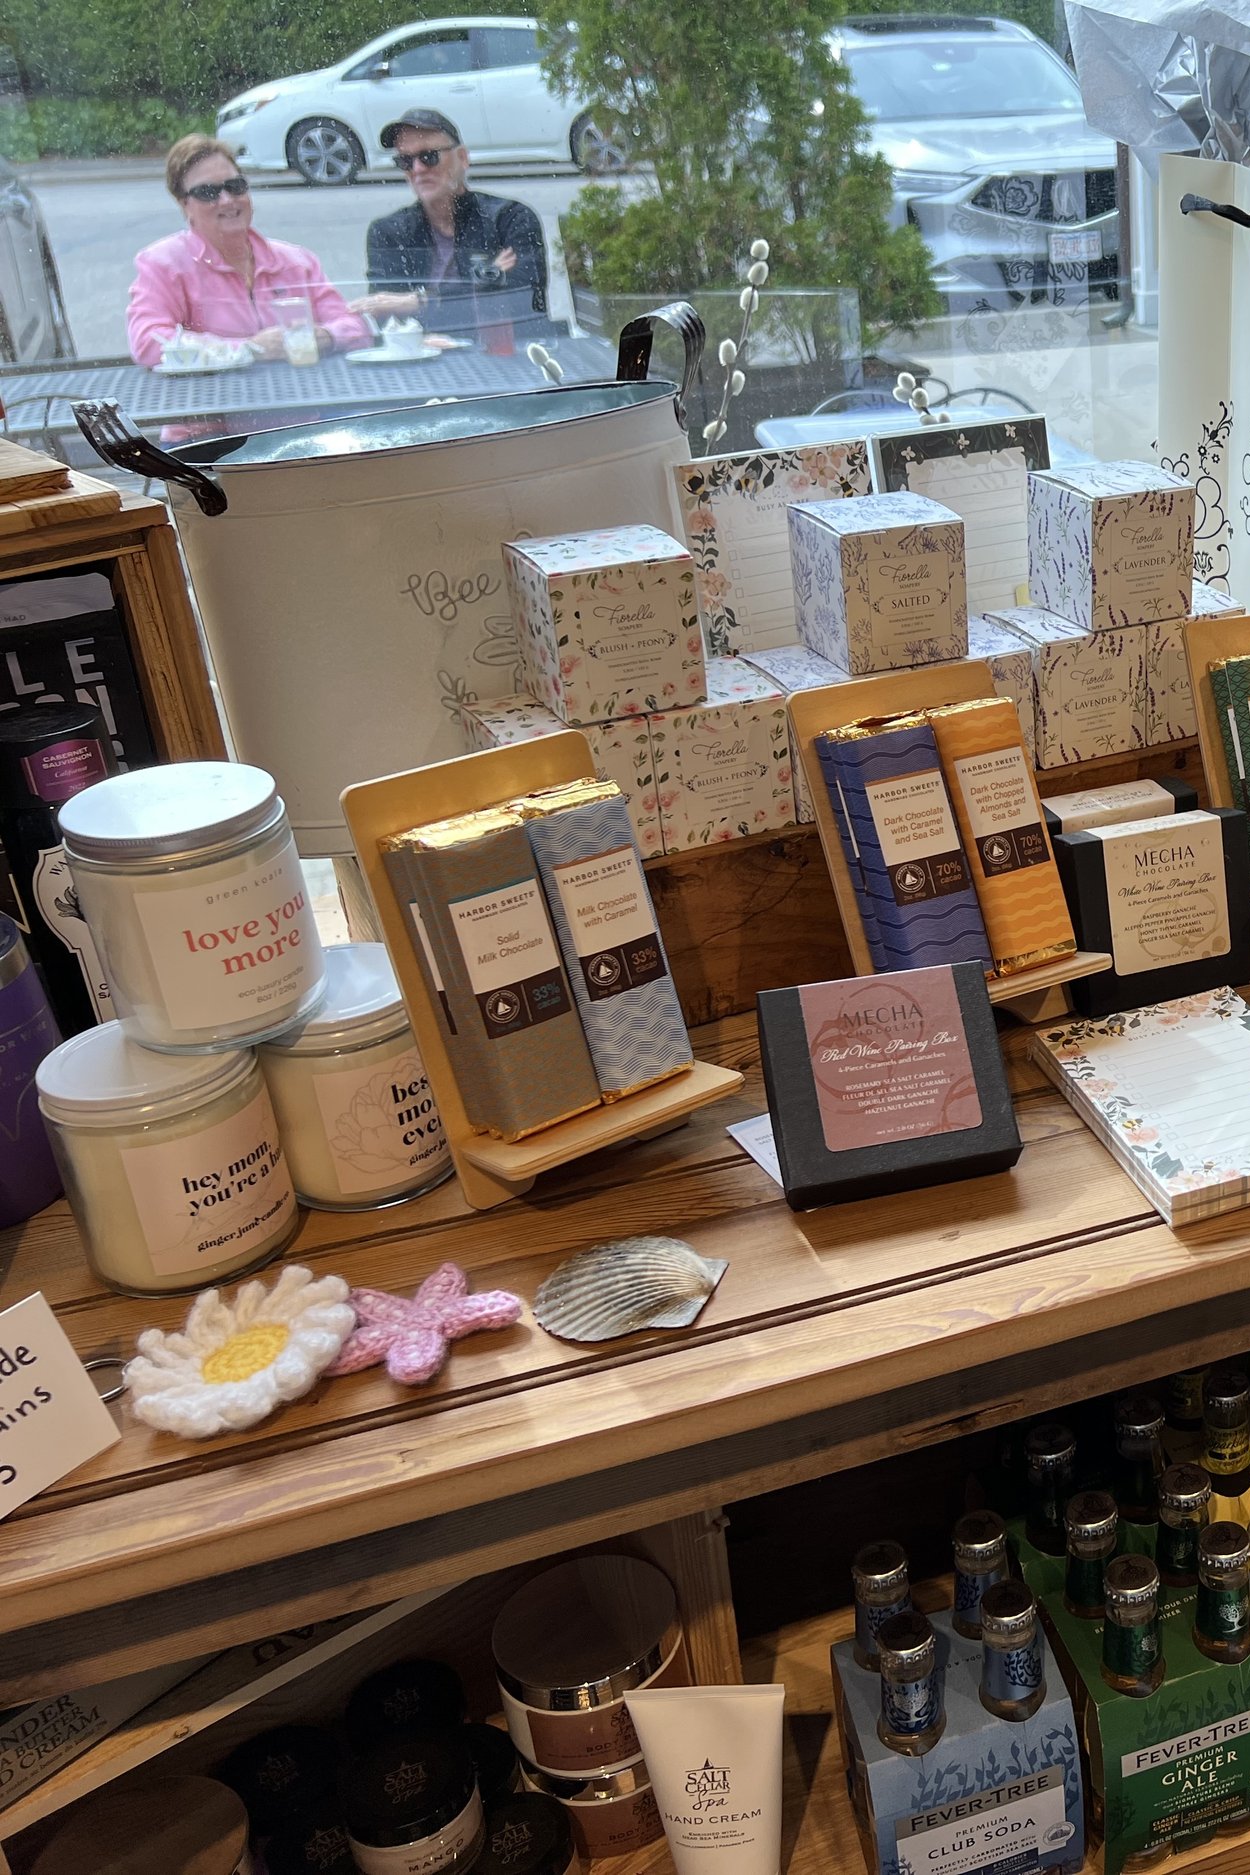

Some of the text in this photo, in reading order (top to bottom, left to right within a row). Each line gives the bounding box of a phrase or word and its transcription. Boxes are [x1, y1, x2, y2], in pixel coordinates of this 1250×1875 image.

[1121, 527, 1165, 545] Fiorella
[1124, 556, 1166, 570] LAVENDER
[879, 564, 932, 583] Fiorella
[400, 570, 501, 621] Bee
[891, 595, 931, 609] SALTED
[593, 604, 656, 625] Fiorella
[600, 637, 666, 655] BLUSH PEONY
[1070, 667, 1116, 686] Fiorella
[1075, 694, 1117, 710] LAVENDER
[43, 747, 89, 763] CABERNET
[691, 740, 749, 761] Fiorella
[42, 752, 92, 770] SAUVIGNON
[698, 769, 758, 788] BLUSH PEONY
[874, 780, 940, 801] HARBOR SWEETS
[975, 786, 1025, 806] with Chopped
[980, 796, 1027, 815] Almonds and
[992, 808, 1021, 823] Sea Salt
[884, 806, 944, 827] Dark Chocolate
[891, 817, 943, 836] with Caramel
[895, 827, 944, 846] and Sea Salt
[1020, 833, 1042, 849] 70%
[1134, 845, 1195, 868] MECHA
[562, 859, 632, 885] HARBOR SWEETS
[936, 861, 962, 876] 70%
[1135, 861, 1197, 878] CHOCOLATE
[206, 867, 284, 905] green koala
[459, 890, 535, 919] HARBOR SWEETS
[577, 891, 638, 918] Milk Chocolate
[183, 891, 305, 953] love you
[584, 904, 638, 929] with Caramel
[496, 930, 520, 946] Solid
[221, 929, 301, 976] more
[477, 936, 544, 965] Milk Chocolate
[631, 947, 658, 966] 33%
[531, 984, 561, 1001] 33%
[843, 1002, 923, 1031] MECHA
[846, 1020, 925, 1039] CHOCOLATE
[820, 1031, 958, 1063] Red Wine Pairing Box
[845, 1069, 945, 1092] ROSEMARY SEA SALT CARAMEL
[858, 1088, 939, 1108] DOUBLE DARK GANACHE
[190, 1164, 270, 1216] you're a
[1158, 1600, 1184, 1612] YOUR
[15, 1707, 84, 1759] BUTTER
[20, 1705, 101, 1771] CREAM
[1176, 1746, 1224, 1769] PREMIUM
[687, 1769, 731, 1784] SALT
[1161, 1750, 1239, 1786] GINGER
[685, 1780, 731, 1794] CELLAR
[1180, 1770, 1218, 1793] ALE
[692, 1788, 729, 1811] Spa
[911, 1775, 1049, 1832] FEVER-TREE
[664, 1809, 762, 1825] HAND CREAM
[955, 1815, 1008, 1838] PREMIUM
[1152, 1813, 1180, 1828] CLASSIC
[928, 1818, 1037, 1860] CLUB SODA
[407, 1837, 465, 1873] MANGO
